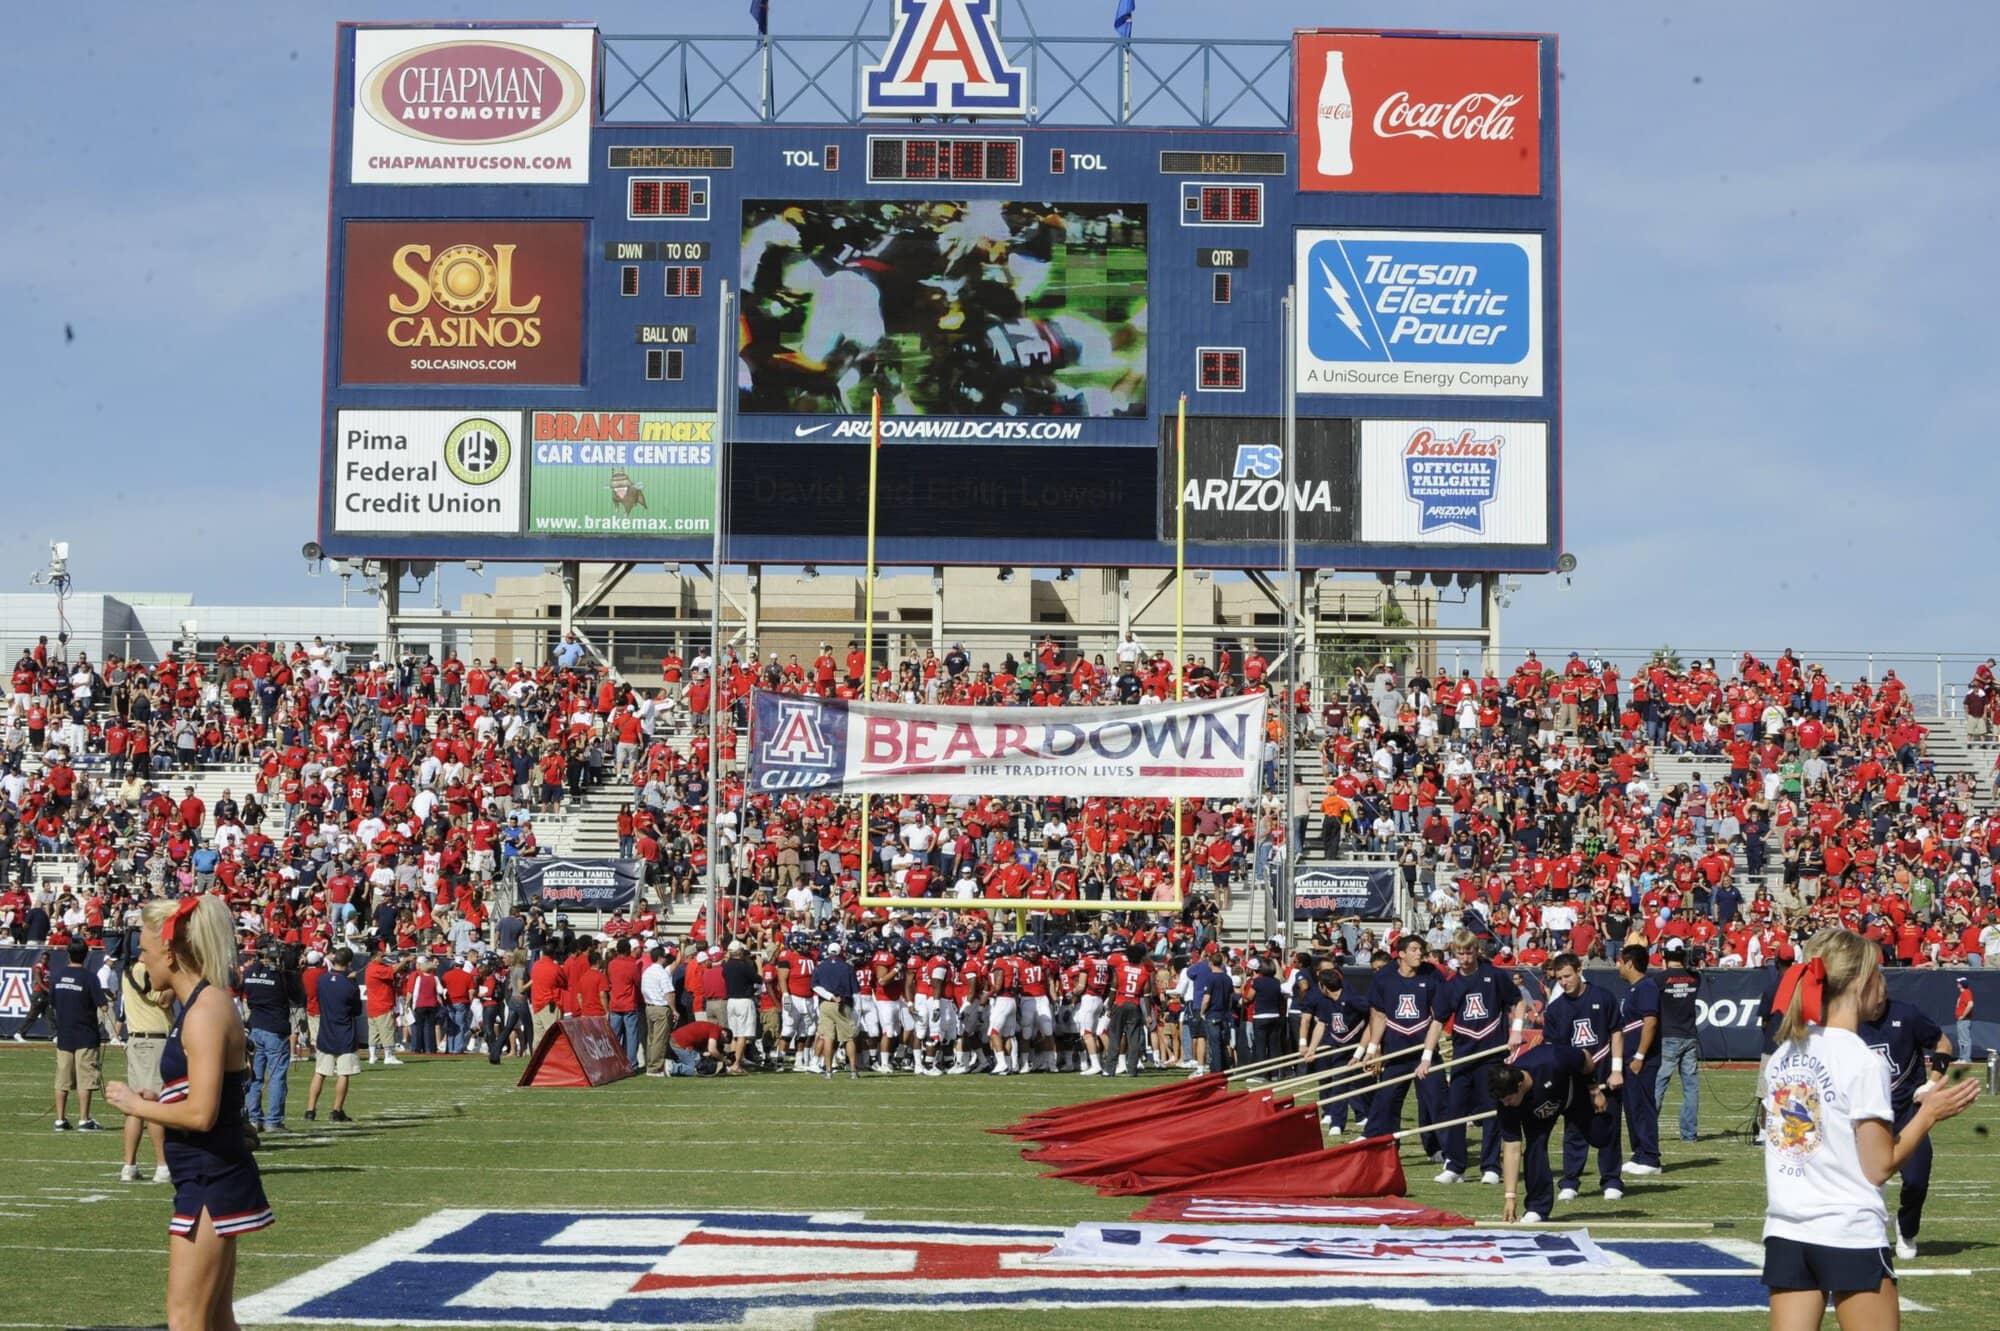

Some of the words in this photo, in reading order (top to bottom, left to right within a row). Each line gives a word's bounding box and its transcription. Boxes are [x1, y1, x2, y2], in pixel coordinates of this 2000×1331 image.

[399, 67, 545, 104] CHAPMAN
[402, 106, 542, 120] AUTOMOTIVE
[1373, 91, 1523, 140] Coca-Cola
[368, 156, 572, 170] CHAPMANTUCSON.COM
[630, 148, 713, 168] ARIZONA
[783, 150, 819, 166] TOL
[1070, 154, 1107, 170] TOL
[1201, 154, 1241, 173] WSU
[618, 243, 642, 259] DWN
[667, 243, 681, 259] TO
[685, 244, 701, 259] GO
[1212, 250, 1233, 266] QTR
[388, 243, 541, 315] SOL
[1365, 255, 1477, 286] Tucson
[1376, 286, 1508, 316] Electric
[387, 317, 541, 348] CASINOS
[643, 327, 668, 342] BALL
[672, 327, 688, 342] ON
[1389, 319, 1507, 345] Power
[410, 359, 516, 370] SOLCASINOS.COM
[1307, 370, 1319, 382] A
[1323, 370, 1398, 383] UniSource
[1403, 371, 1454, 387] Energy
[1459, 371, 1529, 388] Company
[346, 429, 408, 450] Pima
[536, 445, 573, 464] CAR
[580, 445, 627, 464] CARE
[633, 445, 711, 464] CENTERS
[1233, 444, 1283, 479] FS
[346, 461, 437, 482] Federal
[1412, 462, 1490, 474] OFFICIAL
[1412, 475, 1490, 487] TAILGATE
[1176, 479, 1331, 512] ARIZONA
[1413, 488, 1489, 496] HEADQUARTERS
[345, 492, 420, 513] Credit
[428, 492, 501, 513] Union
[1426, 506, 1478, 515] ARIZONA
[536, 514, 710, 531] www.brakemax.com
[761, 770, 831, 789] CLUB
[972, 765, 998, 776] THE
[1005, 765, 1087, 776] TRADITION
[1094, 766, 1134, 776] LIVES
[543, 870, 584, 878] AMERICAN
[586, 870, 615, 878] FAMILY
[1296, 880, 1338, 888] AMERICAN
[1340, 880, 1368, 888] FAMILY
[1769, 1053, 1836, 1104] OMECOMING
